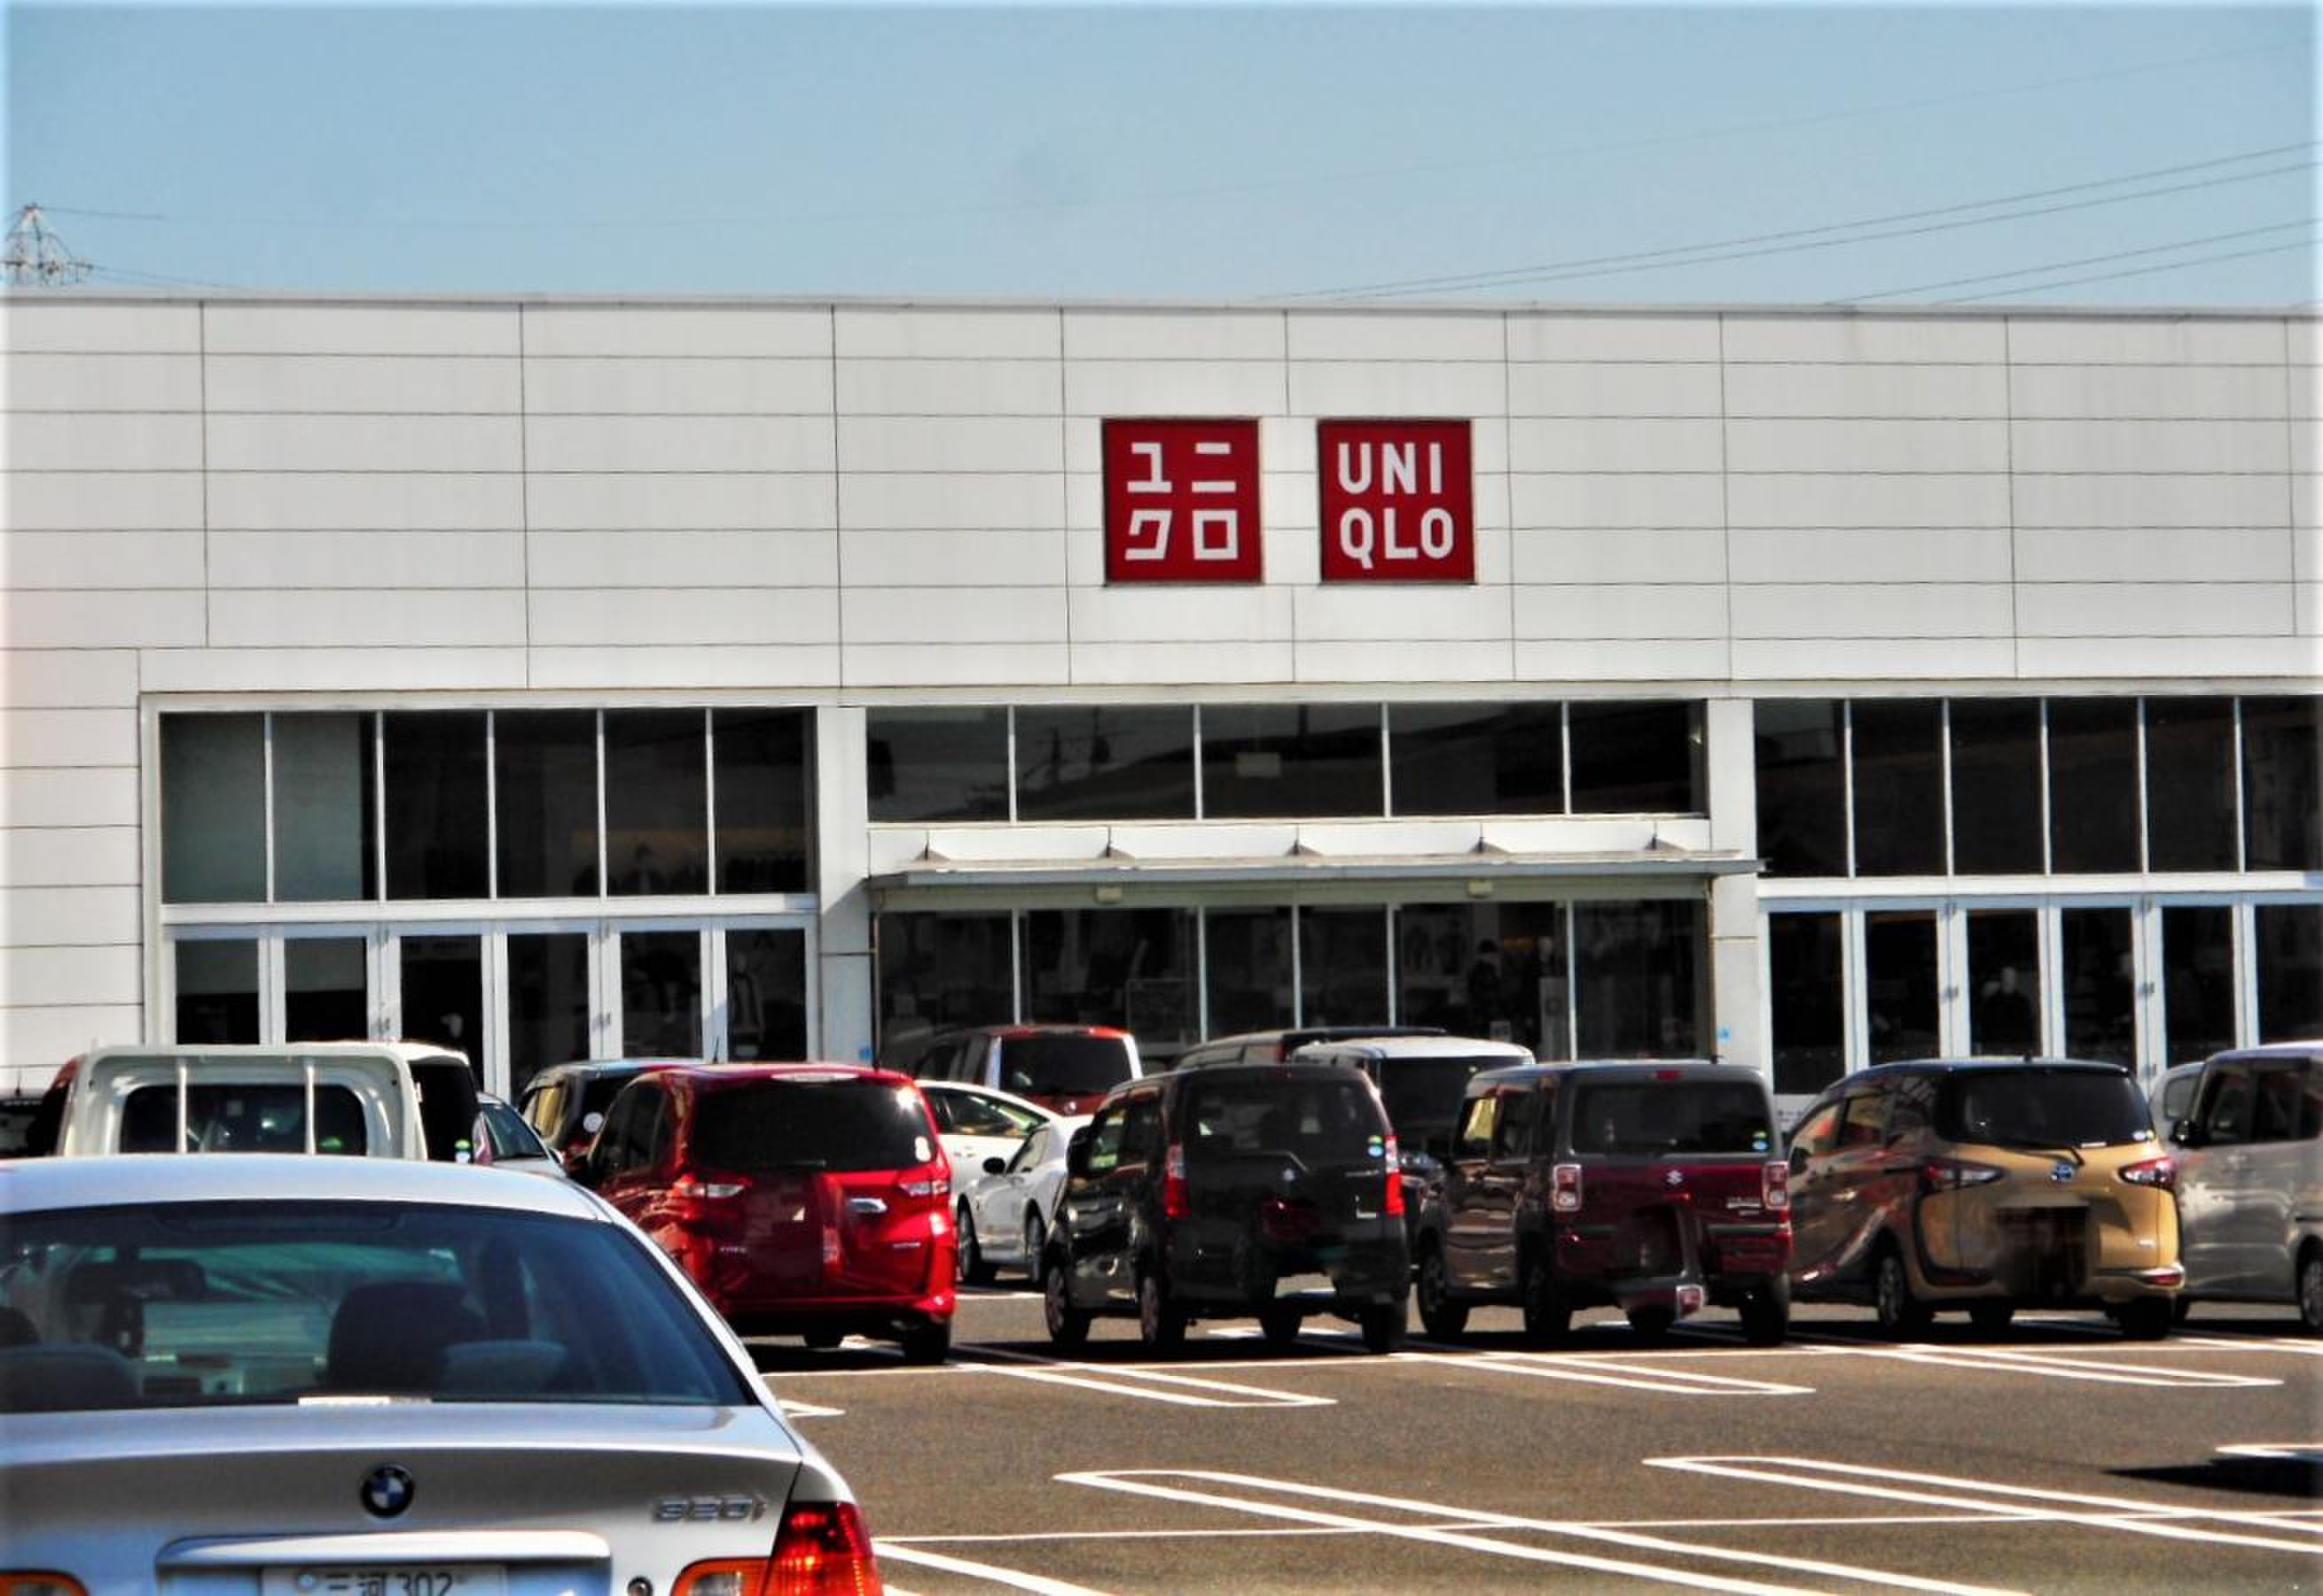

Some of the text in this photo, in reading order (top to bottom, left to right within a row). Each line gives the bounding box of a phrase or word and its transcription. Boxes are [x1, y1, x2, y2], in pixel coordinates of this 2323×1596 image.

[1127, 442, 1237, 493] ユニ
[1337, 442, 1443, 495] UNI
[1124, 508, 1239, 560] クロ
[1340, 507, 1454, 568] QLO
